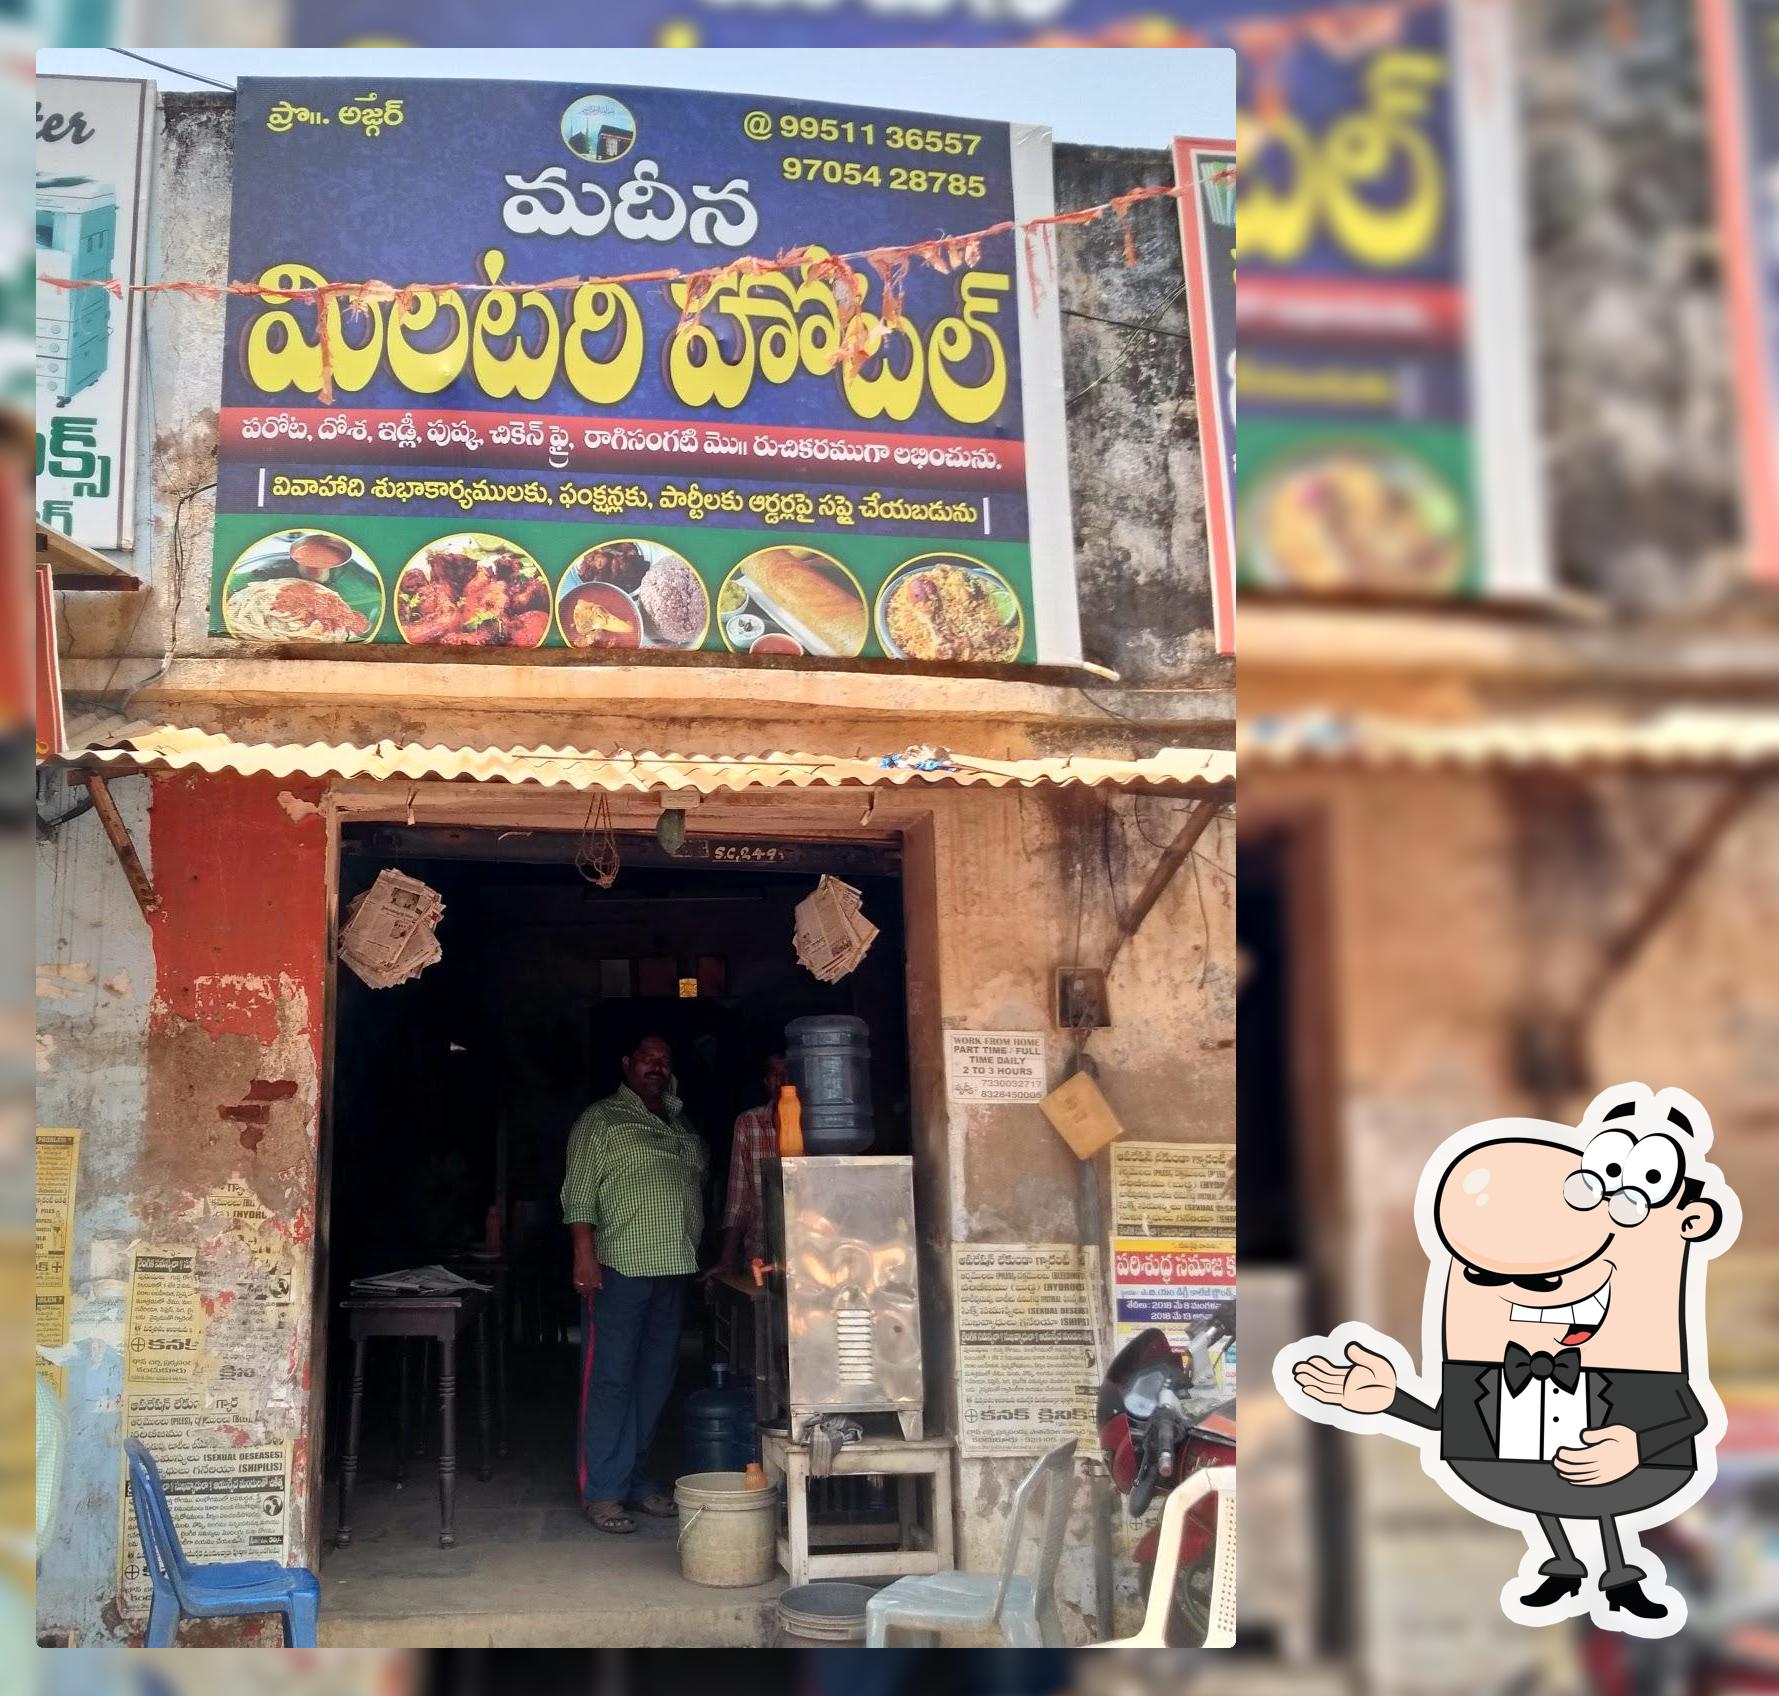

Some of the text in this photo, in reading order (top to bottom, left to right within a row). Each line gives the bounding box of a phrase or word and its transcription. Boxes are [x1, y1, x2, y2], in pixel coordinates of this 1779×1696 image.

[780, 114, 875, 146] 99511
[885, 126, 982, 156] 36557
[782, 157, 986, 197] 97054 28785
[502, 159, 758, 247] మదీన
[668, 245, 1010, 424] హోటల్
[241, 412, 313, 442] పరోట,
[318, 414, 372, 444] దోశ,
[377, 412, 422, 449] ఇడ్లీ,
[489, 421, 544, 446] చికెన్
[584, 427, 699, 454] రాగిసంగటి
[753, 434, 890, 463] రుచికరముగా
[894, 445, 1002, 471] లభించును.
[272, 475, 365, 498] వివాహాది
[370, 477, 553, 510] శుభాకార్యములకు,
[659, 483, 743, 520] పార్టీలకు
[858, 491, 978, 523] చేయబడును
[953, 1036, 1041, 1046] WORK FROM HOME
[953, 1046, 979, 1054] PART
[983, 1046, 1007, 1055] TIME
[1015, 1047, 1041, 1056] FULL
[969, 1056, 1026, 1065] TIME DAILY
[962, 1066, 1033, 1076] 2 TO 3 HOURS
[1151, 1301, 1172, 1310] 2018
[1150, 1312, 1172, 1320] 2018
[203, 1452, 237, 1462] (SEXUAL
[238, 1450, 283, 1461] DESEASES)
[238, 1462, 283, 1474] (SHIPILIS)
